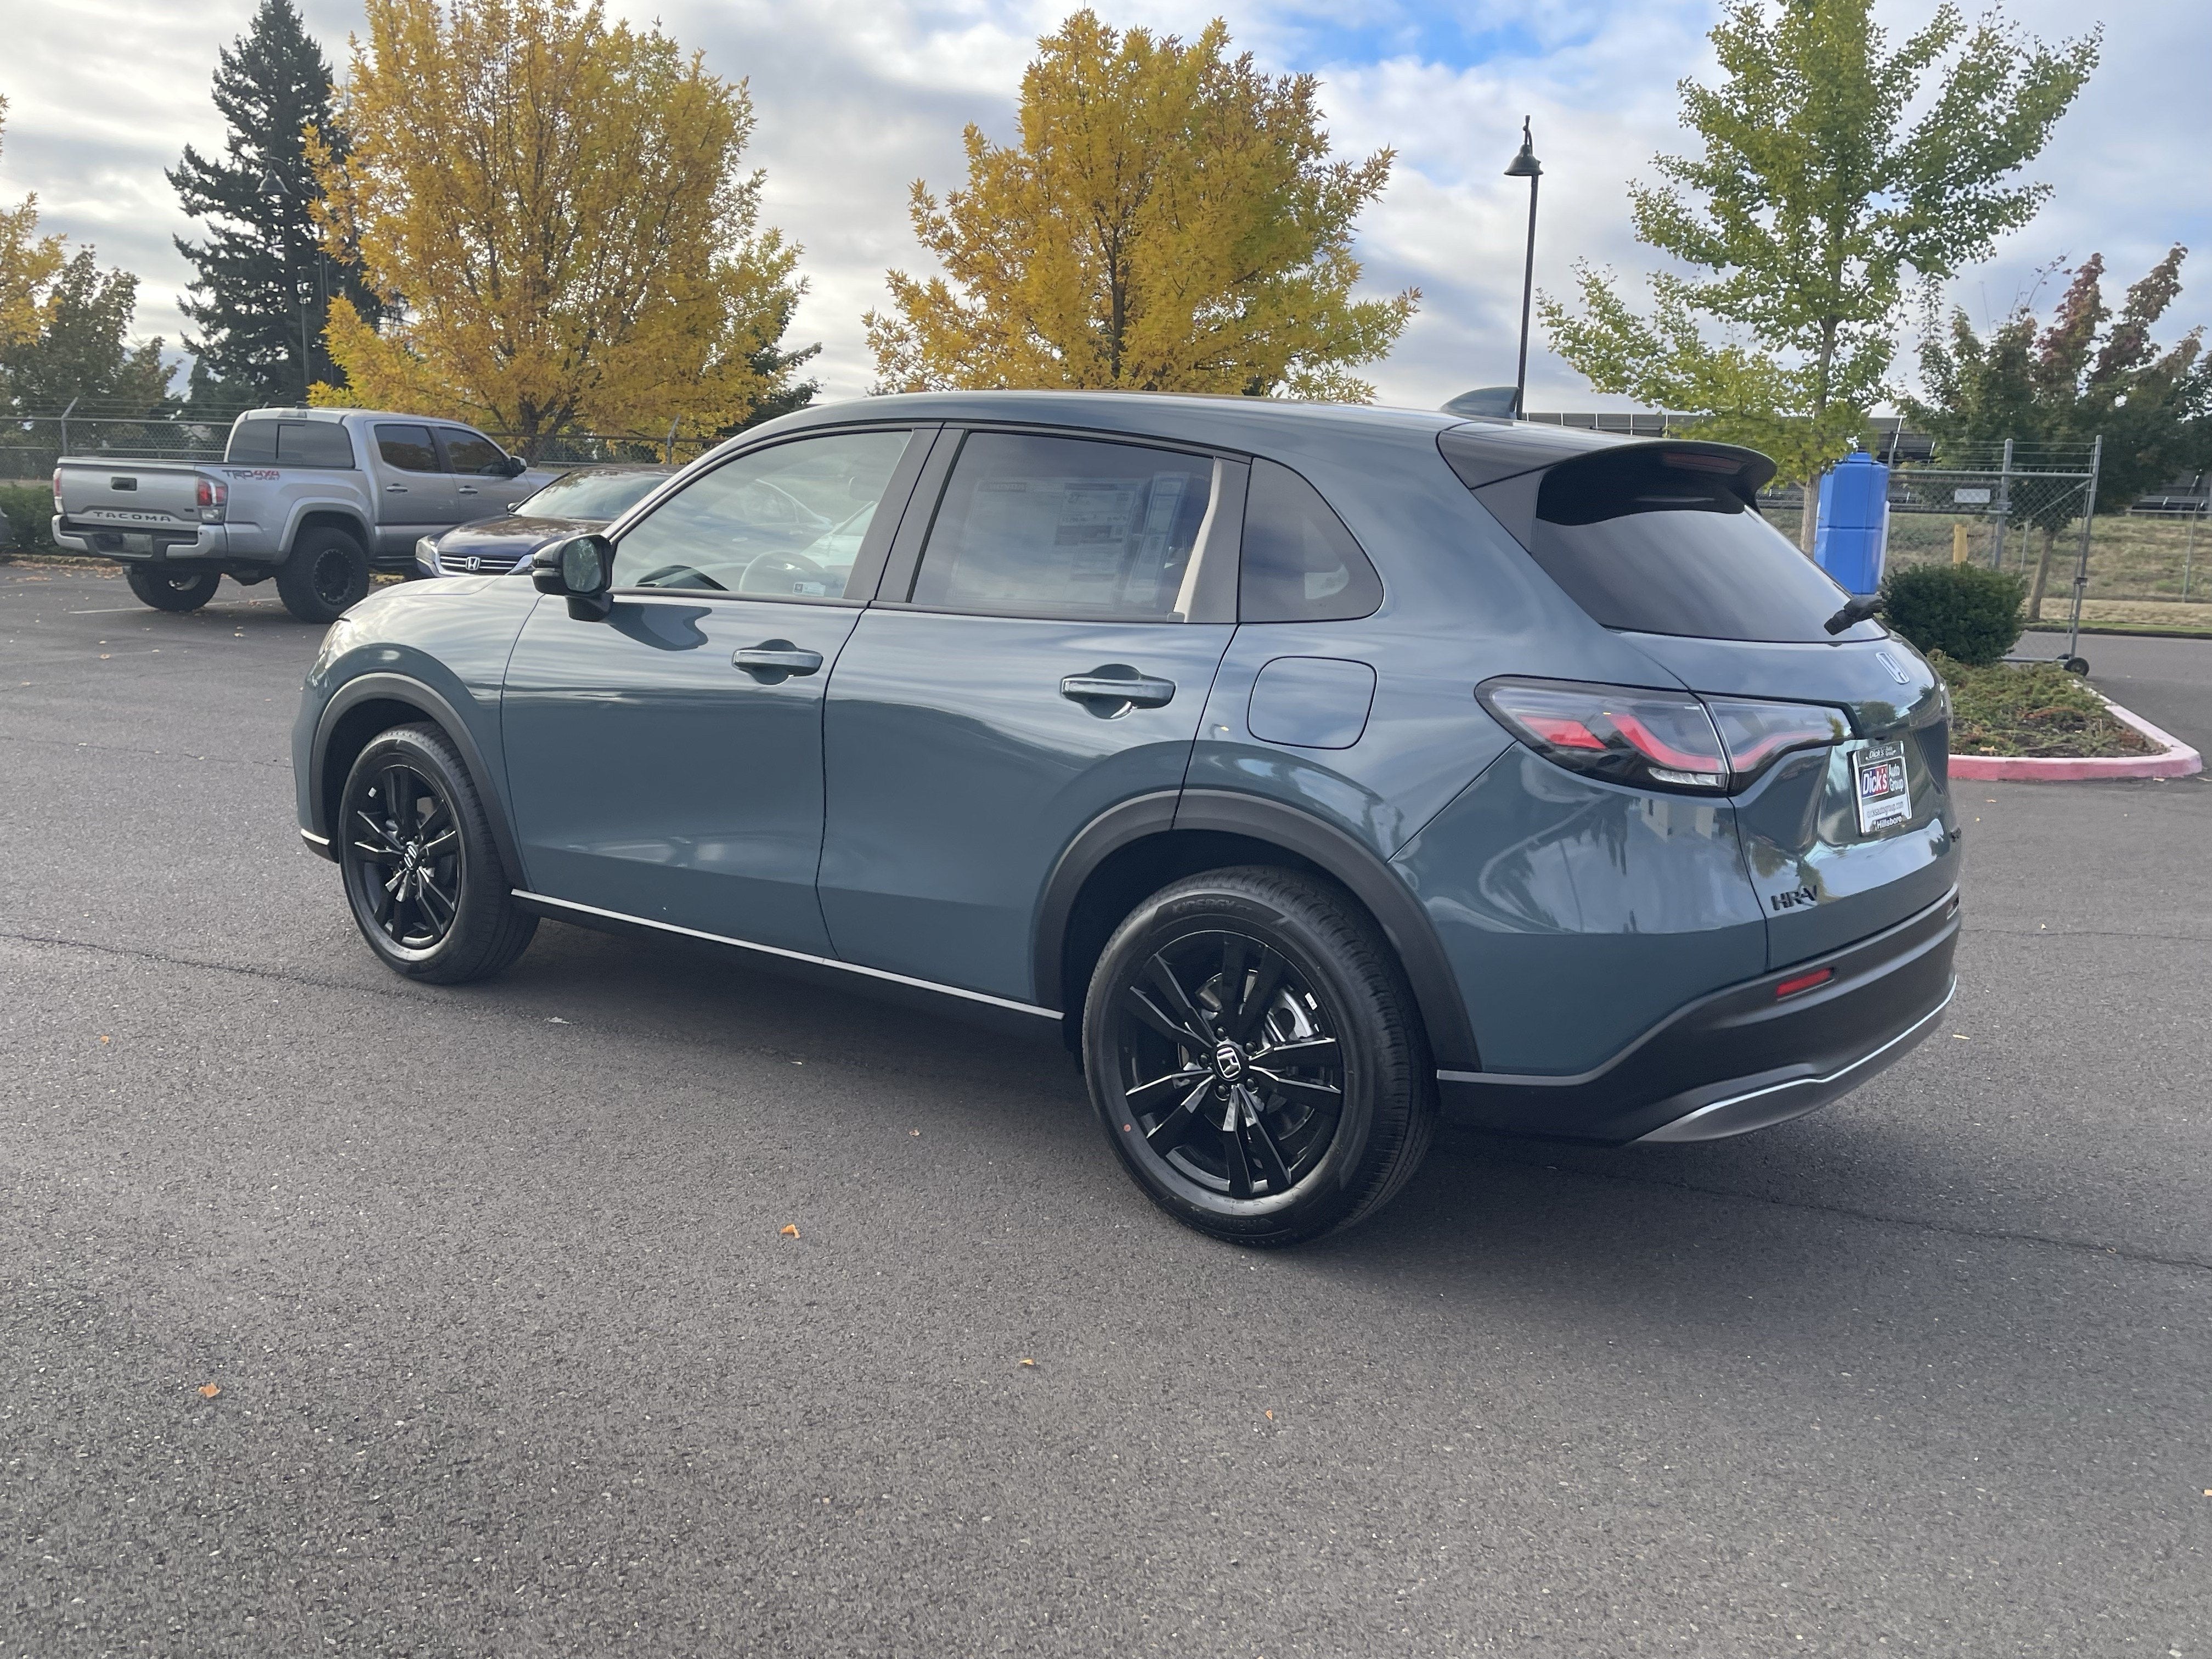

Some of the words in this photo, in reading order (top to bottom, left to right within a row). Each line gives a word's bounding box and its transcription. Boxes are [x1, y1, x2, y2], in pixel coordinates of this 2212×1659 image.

[222, 470, 253, 479] TRD
[93, 511, 171, 522] TACOMA
[1863, 769, 1887, 795] Dick's
[1888, 763, 1900, 777] Auto
[1889, 778, 1904, 792] Group
[1877, 816, 1902, 830] Hillsboro
